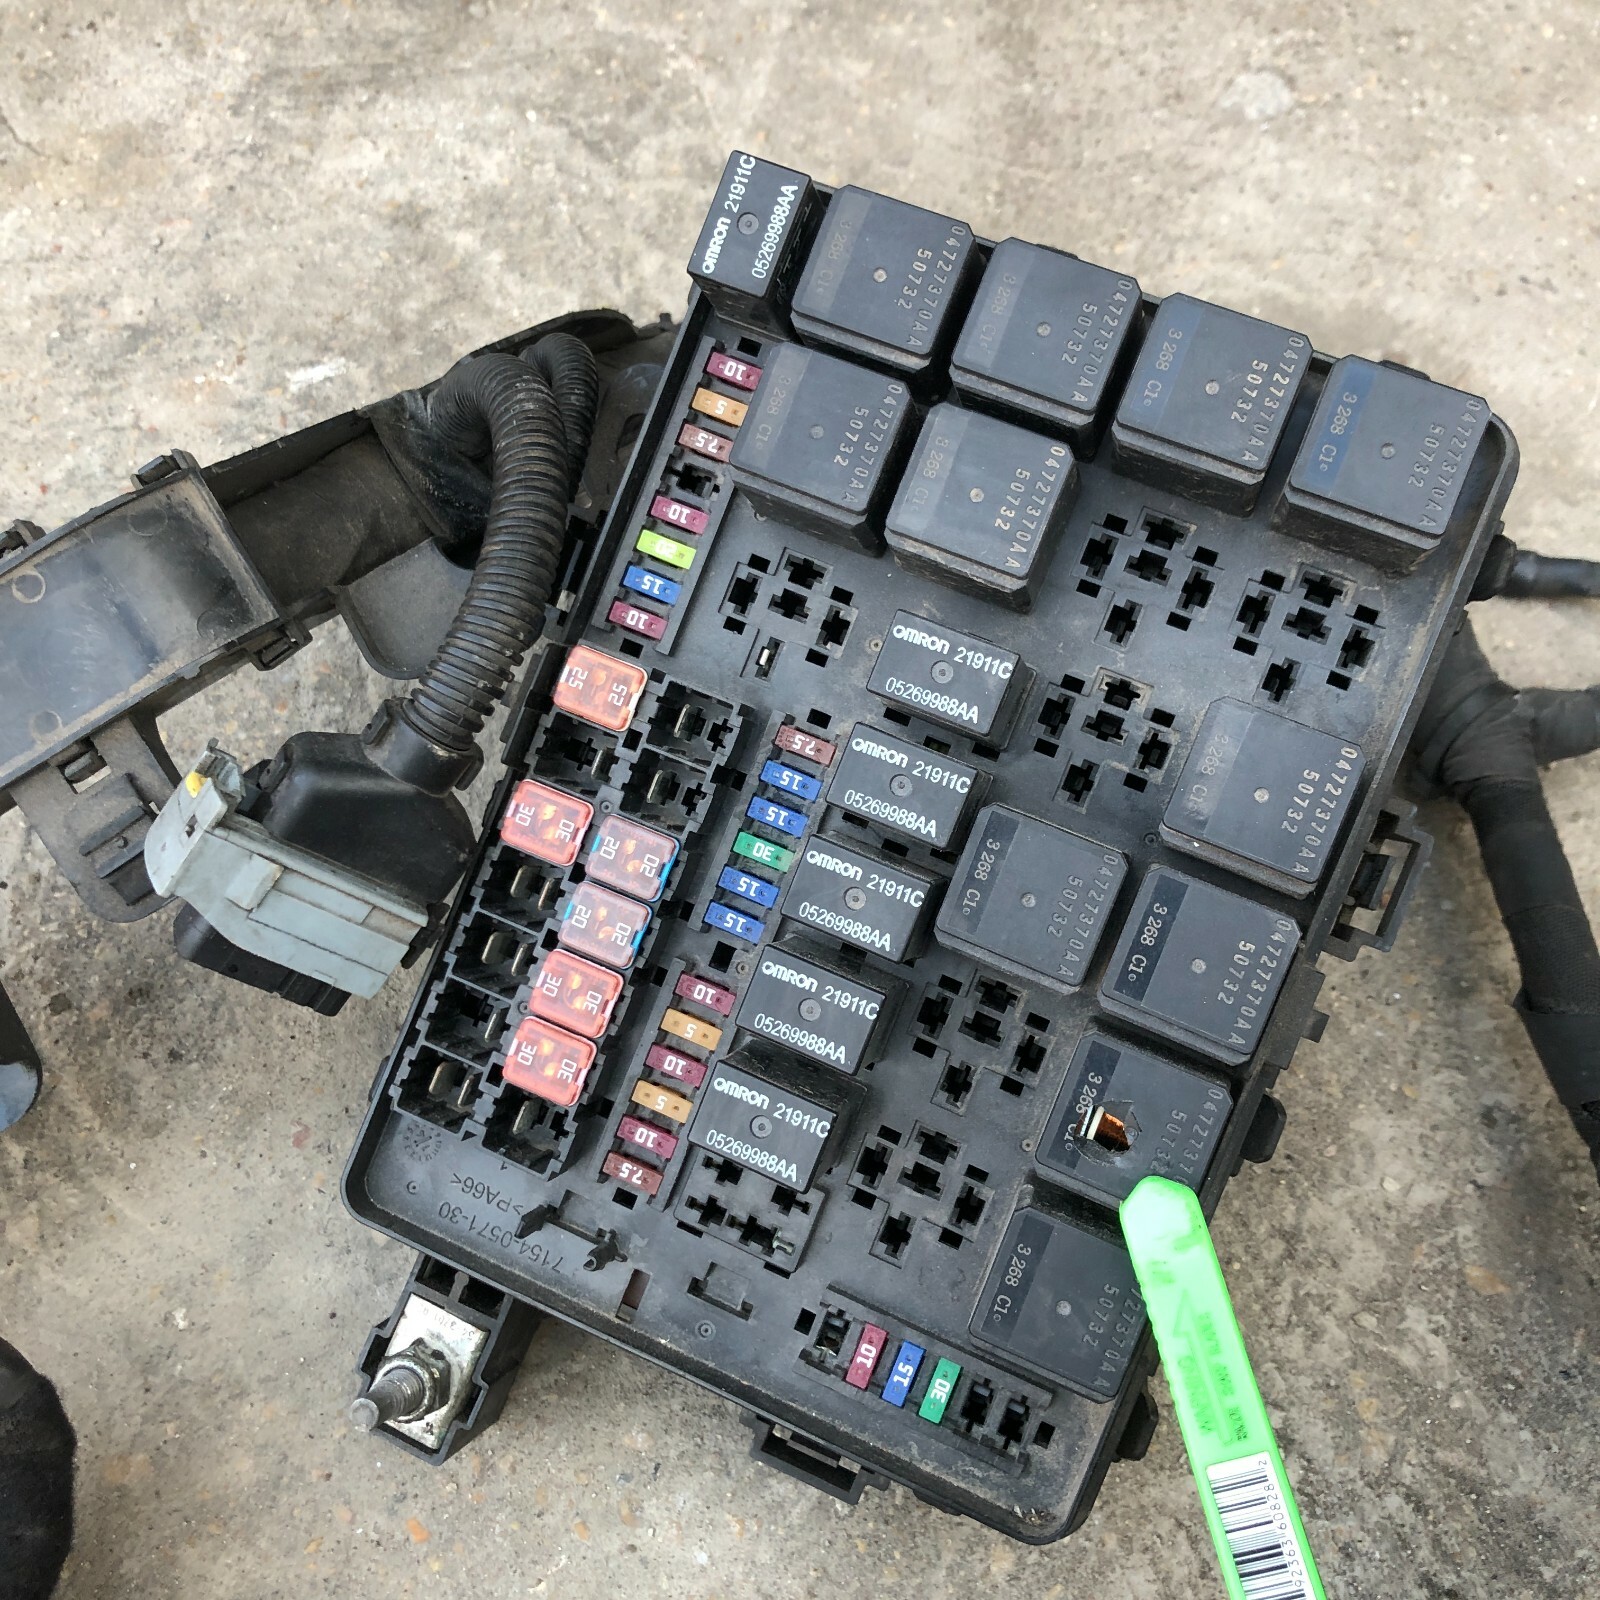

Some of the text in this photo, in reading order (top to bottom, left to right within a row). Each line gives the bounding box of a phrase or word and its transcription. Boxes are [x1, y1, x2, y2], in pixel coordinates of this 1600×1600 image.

[724, 155, 756, 213] 21911C
[751, 185, 798, 279] 05269988AA
[898, 248, 932, 309] 50732
[1062, 303, 1097, 365] 50732
[724, 361, 747, 381] 10
[1231, 359, 1269, 423] 50732
[715, 400, 728, 415] 5
[695, 432, 718, 454] 7.5
[833, 406, 870, 467] 50732
[1408, 424, 1445, 488] 50732
[994, 468, 1031, 532] 50732
[668, 504, 690, 524] 10
[641, 574, 664, 595] 15
[626, 610, 649, 630] 10
[953, 646, 1013, 679] 21911C
[568, 666, 588, 690] 25
[607, 682, 628, 707] 25
[885, 676, 979, 724] 05269988AA
[792, 734, 817, 756] 7.5
[779, 770, 803, 791] 15
[912, 760, 971, 794] 21911C
[515, 802, 536, 827] 30
[844, 789, 936, 838] 05269988AA
[1281, 769, 1321, 834] 50732
[765, 806, 789, 827] 15
[555, 819, 575, 843] 30
[600, 836, 620, 860] 20
[752, 842, 776, 862] 30
[639, 853, 661, 878] 20
[737, 876, 760, 897] 15
[866, 874, 925, 908] 21911C
[571, 904, 592, 929] 20
[1047, 875, 1083, 938] 50732
[611, 922, 632, 947] 20
[723, 912, 747, 933] 15
[799, 901, 891, 952] 05269988AA
[542, 972, 563, 998] 30
[1217, 940, 1256, 1005] 50732
[582, 990, 603, 1015] 30
[693, 984, 717, 1005] 10
[821, 985, 880, 1020] 21911C
[684, 1023, 698, 1039] 5
[754, 1013, 846, 1065] 05269988AA
[517, 1040, 538, 1066] 30
[663, 1055, 687, 1076] 10
[557, 1058, 578, 1084] 30
[655, 1095, 668, 1111] 5
[773, 1102, 831, 1138] 21911C
[634, 1127, 658, 1148] 10
[706, 1129, 798, 1183] 05269988AA
[618, 1162, 643, 1185] 7.5
[438, 1201, 564, 1273] 7154-0571-30
[1083, 1283, 1119, 1347] 50732
[856, 1343, 877, 1369] 10
[893, 1361, 914, 1388] 15
[930, 1378, 951, 1404] 30
